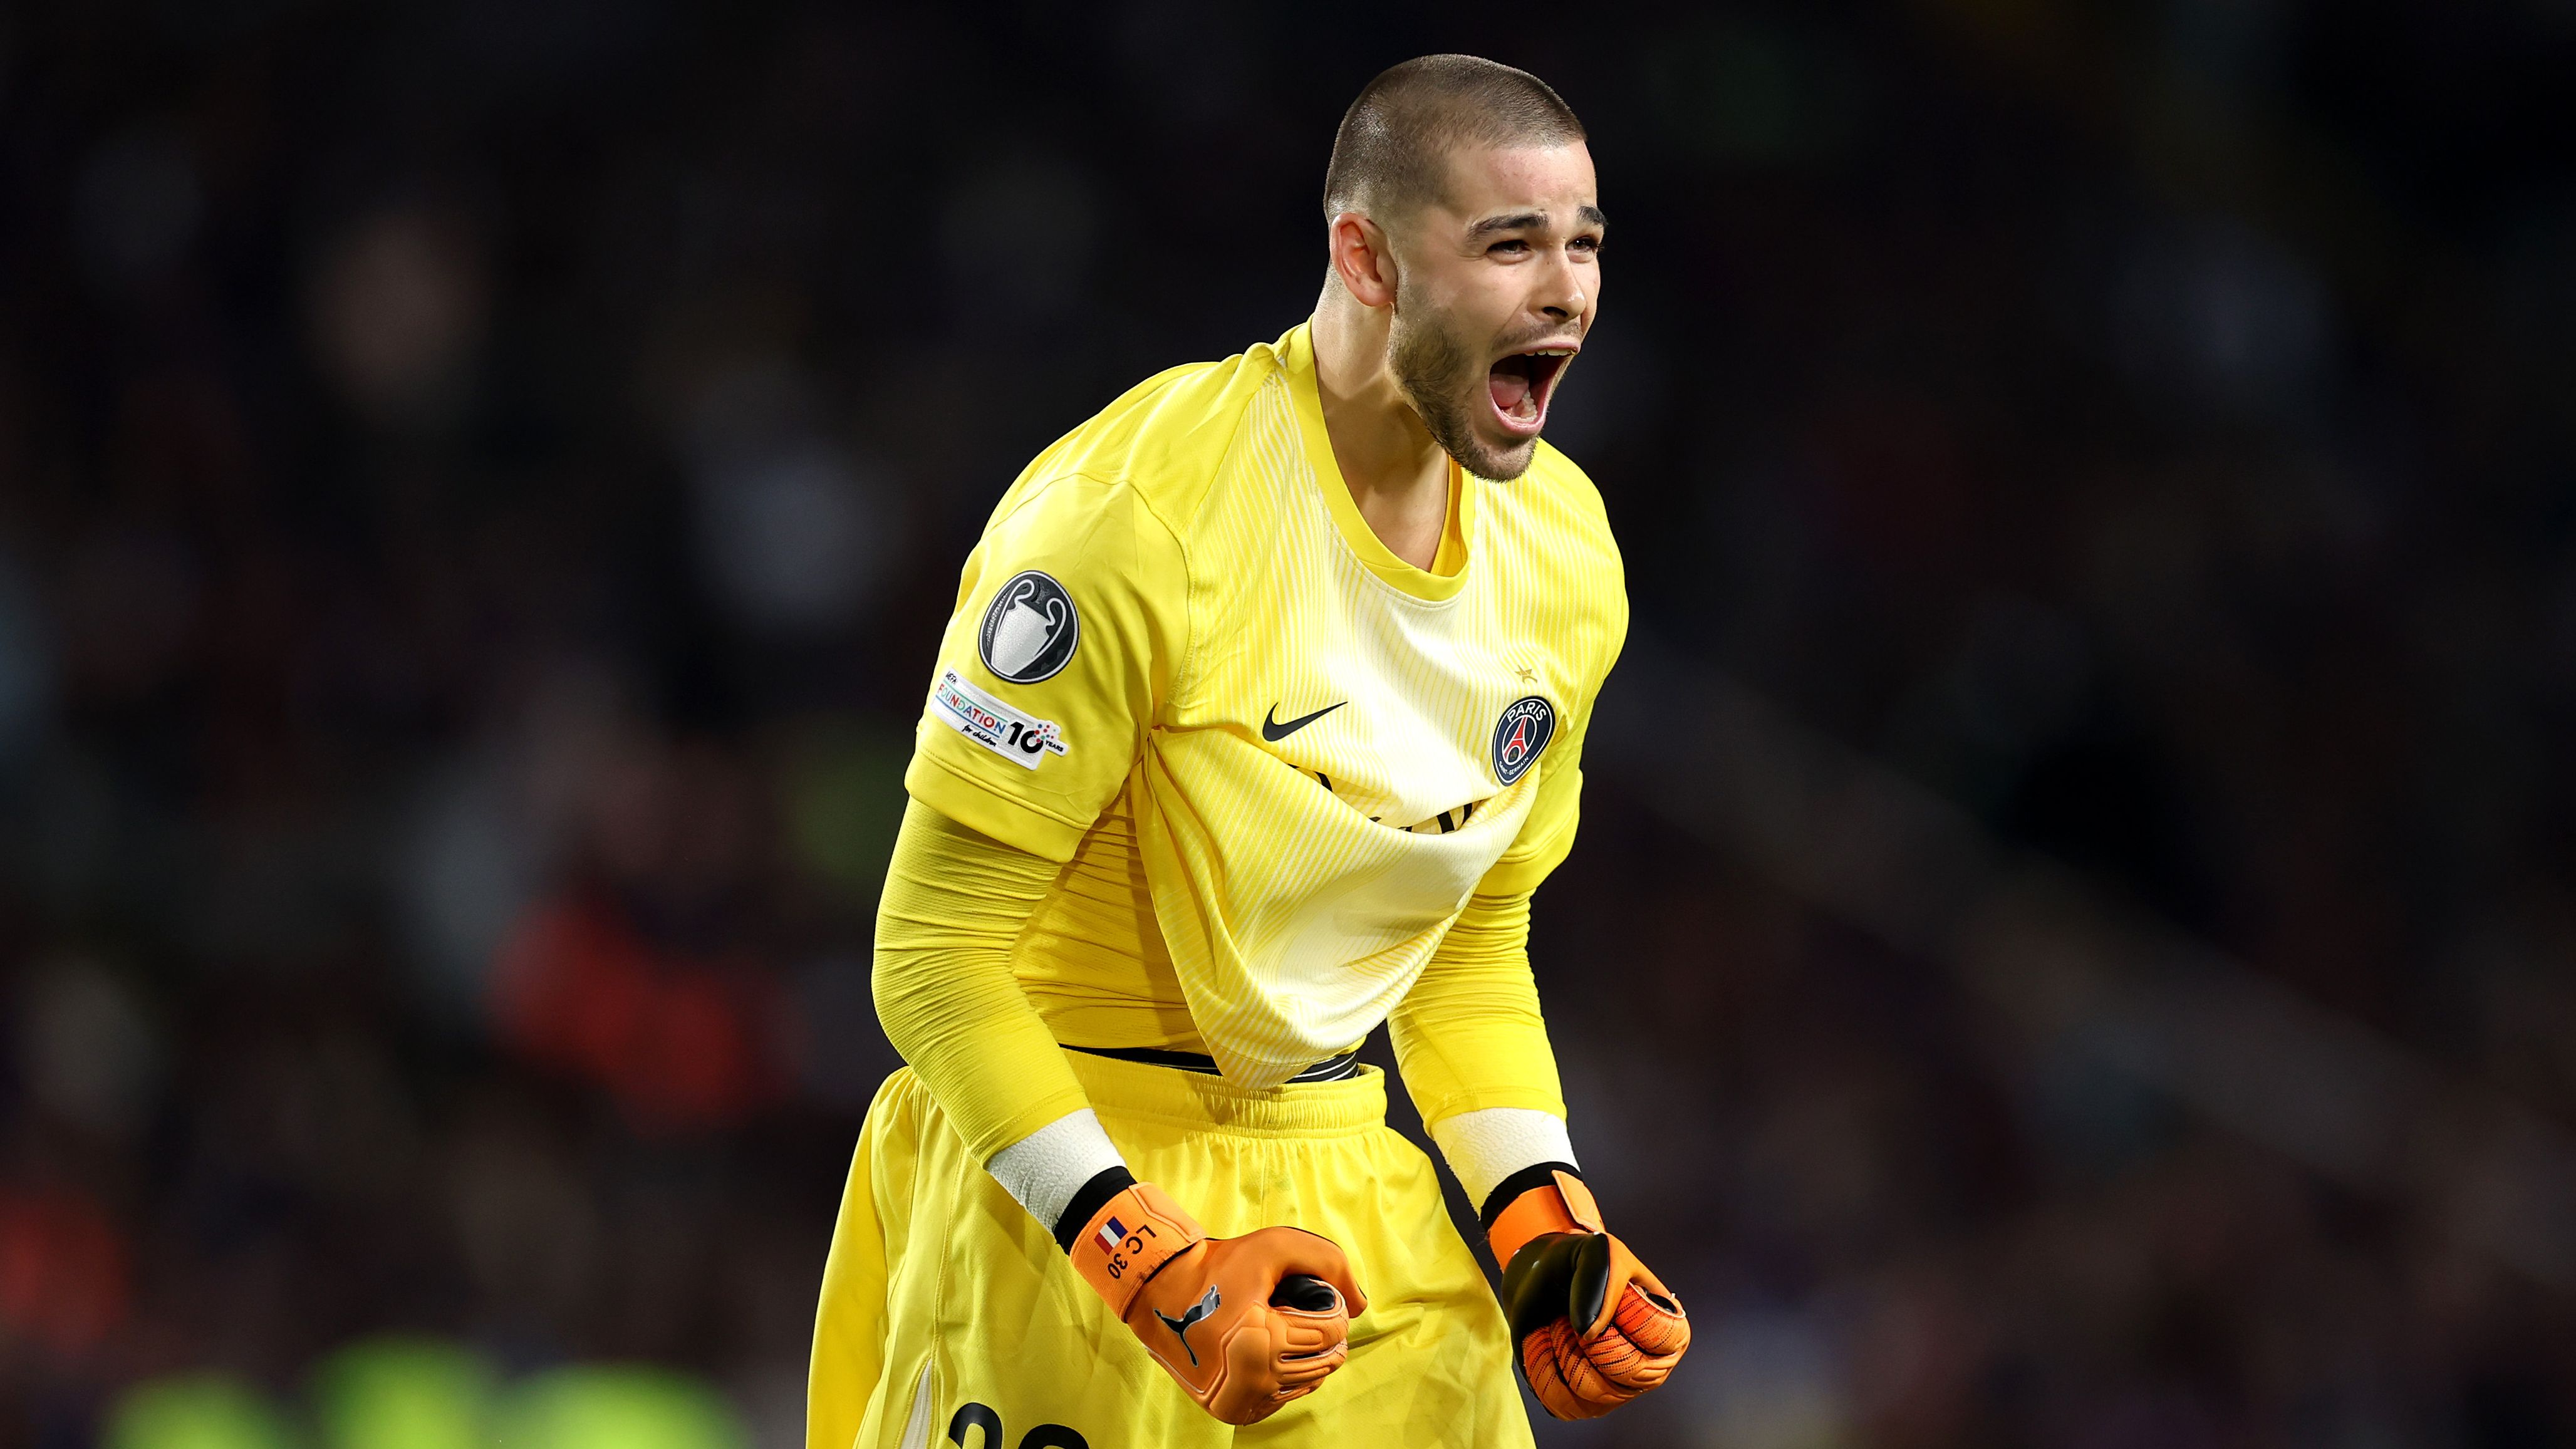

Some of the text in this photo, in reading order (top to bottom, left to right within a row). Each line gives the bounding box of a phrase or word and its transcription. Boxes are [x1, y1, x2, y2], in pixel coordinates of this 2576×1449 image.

[1507, 702, 1547, 723] PARIS
[962, 724, 997, 746] for children
[1008, 721, 1064, 754] 10 YEARS
[1107, 1253, 1128, 1279] 30
